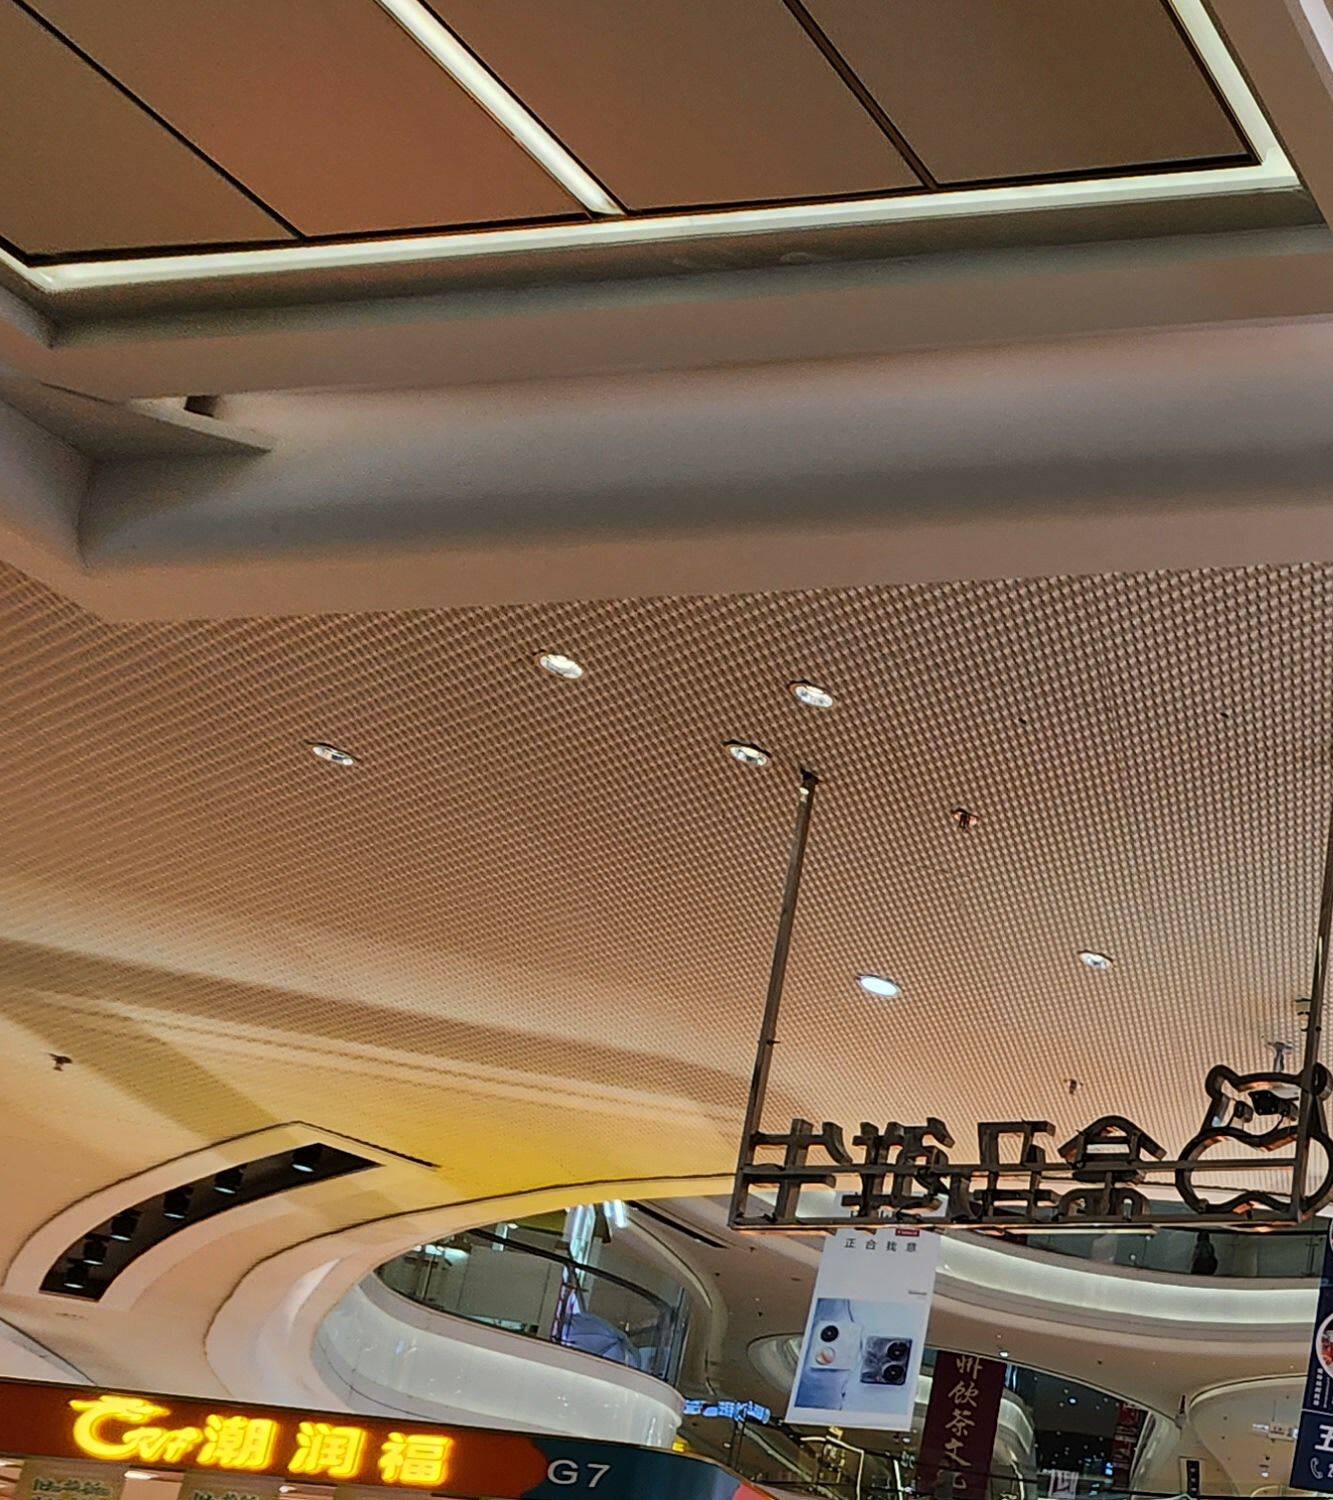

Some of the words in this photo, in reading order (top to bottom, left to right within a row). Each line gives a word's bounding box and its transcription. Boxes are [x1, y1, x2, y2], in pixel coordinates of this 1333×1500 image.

[197, 1414, 453, 1486] 潮润福
[548, 1459, 611, 1488] G7
